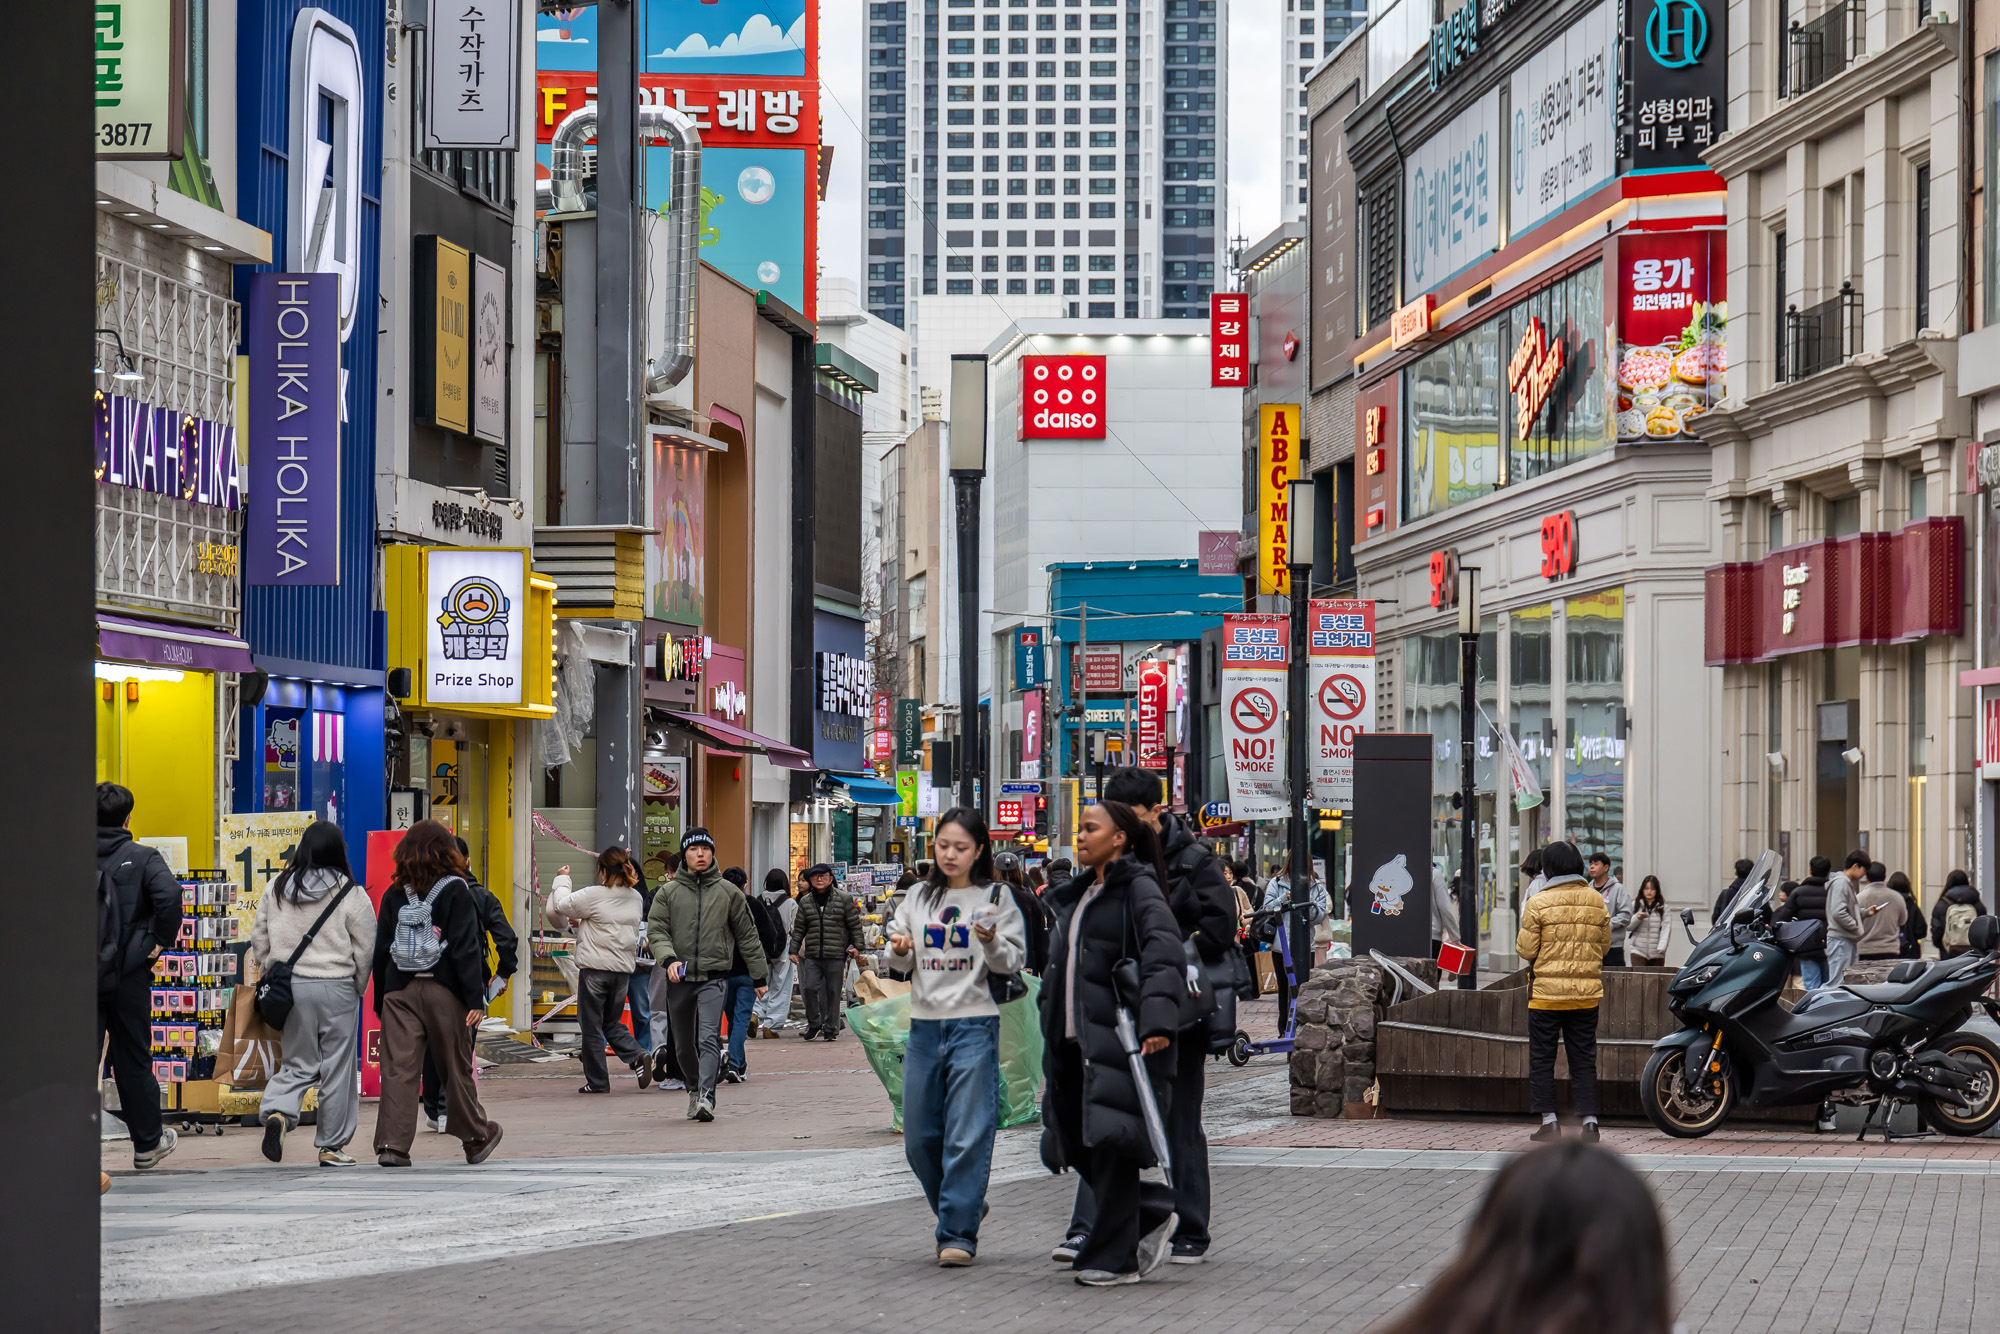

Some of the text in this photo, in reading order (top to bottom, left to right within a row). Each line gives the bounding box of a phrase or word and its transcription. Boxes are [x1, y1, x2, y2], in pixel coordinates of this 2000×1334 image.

[458, 5, 486, 112] 수작카츠
[1539, 46, 1605, 146] 성형외과 피부과
[1638, 96, 1713, 125] 성형외과
[1428, 130, 1489, 258] 헤이븐의원
[1632, 256, 1695, 292] 용가
[1632, 292, 1686, 311] 회전훠궈
[1219, 299, 1241, 382] 금강제화
[276, 280, 309, 577] HOLIKA HOLIKA
[1034, 409, 1097, 429] daiso
[95, 388, 157, 493] OLIKA
[1271, 411, 1289, 588] ABC-MART
[1319, 614, 1365, 631] 동성로
[1234, 628, 1279, 645] 동성로
[1312, 631, 1372, 648] 금연거리
[443, 636, 508, 660] 캐칭덕
[1226, 645, 1286, 662] 금연거리
[435, 673, 514, 688] Prize Shop
[1084, 709, 1139, 722] STREET PIZA
[1141, 685, 1158, 758] GAME
[905, 702, 913, 757] CROCODILE
[1232, 738, 1275, 760] NO!
[1321, 748, 1354, 758] SMOK
[1235, 761, 1274, 772] SMOKE
[229, 830, 244, 840] 상위
[245, 826, 257, 839] 1%
[257, 829, 270, 838] 귀족
[272, 827, 293, 837] 피부의
[236, 900, 259, 911] 24K
[234, 1096, 261, 1106] HOLIK
